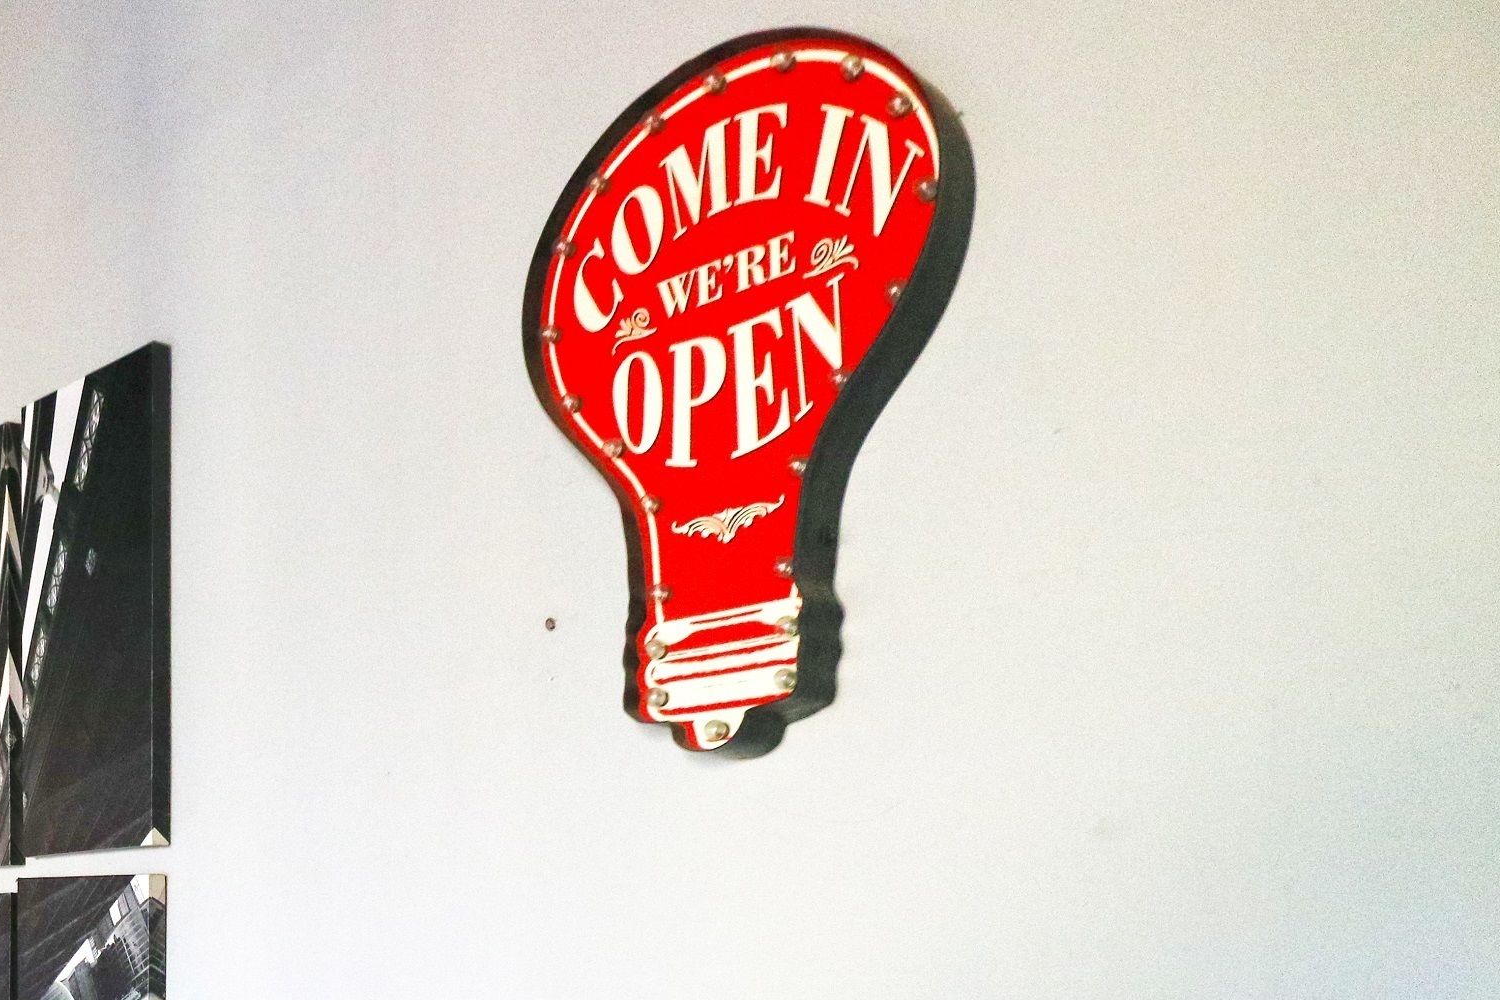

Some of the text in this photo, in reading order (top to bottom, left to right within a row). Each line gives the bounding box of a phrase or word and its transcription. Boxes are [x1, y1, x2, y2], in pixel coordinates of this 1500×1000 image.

[573, 102, 925, 333] COME IN
[656, 231, 797, 319] WE'RE
[612, 272, 845, 468] OPEN
